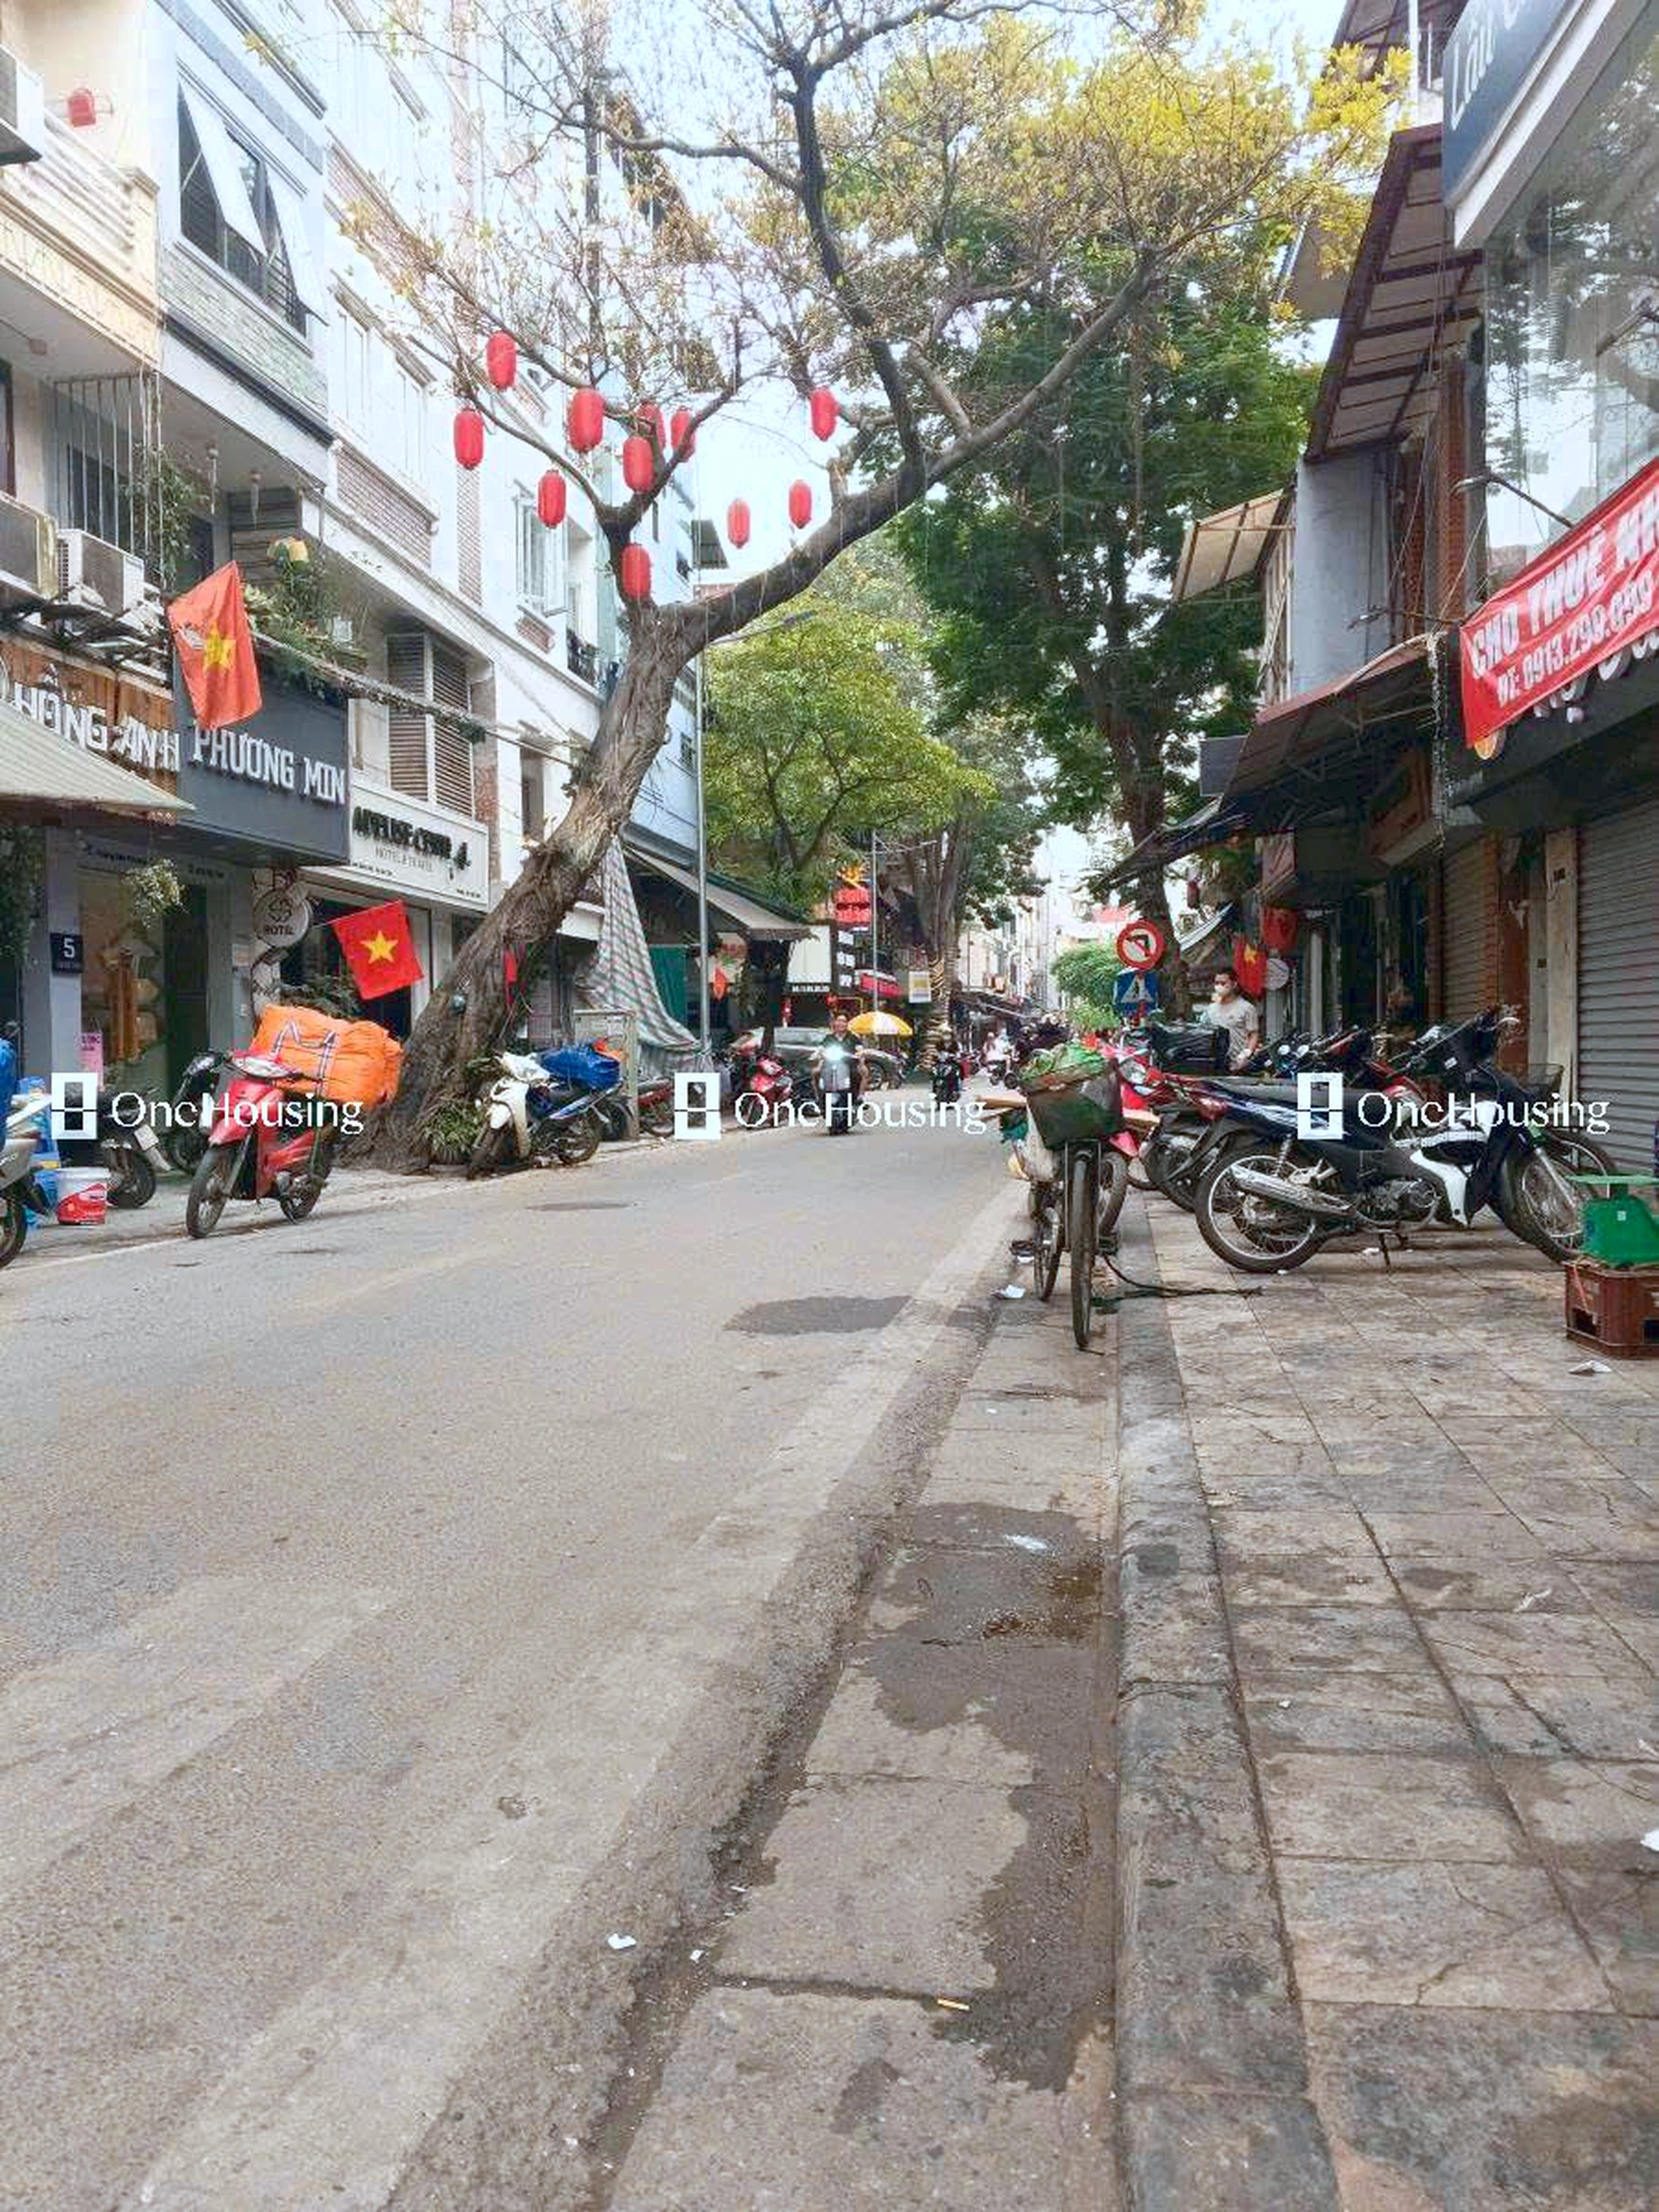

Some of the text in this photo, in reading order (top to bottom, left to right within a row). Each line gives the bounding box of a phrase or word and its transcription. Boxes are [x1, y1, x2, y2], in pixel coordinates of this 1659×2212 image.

[1472, 602, 1519, 681] CHO
[1527, 523, 1606, 637] THUÊ
[303, 756, 345, 805] MIN
[63, 937, 76, 959] 5
